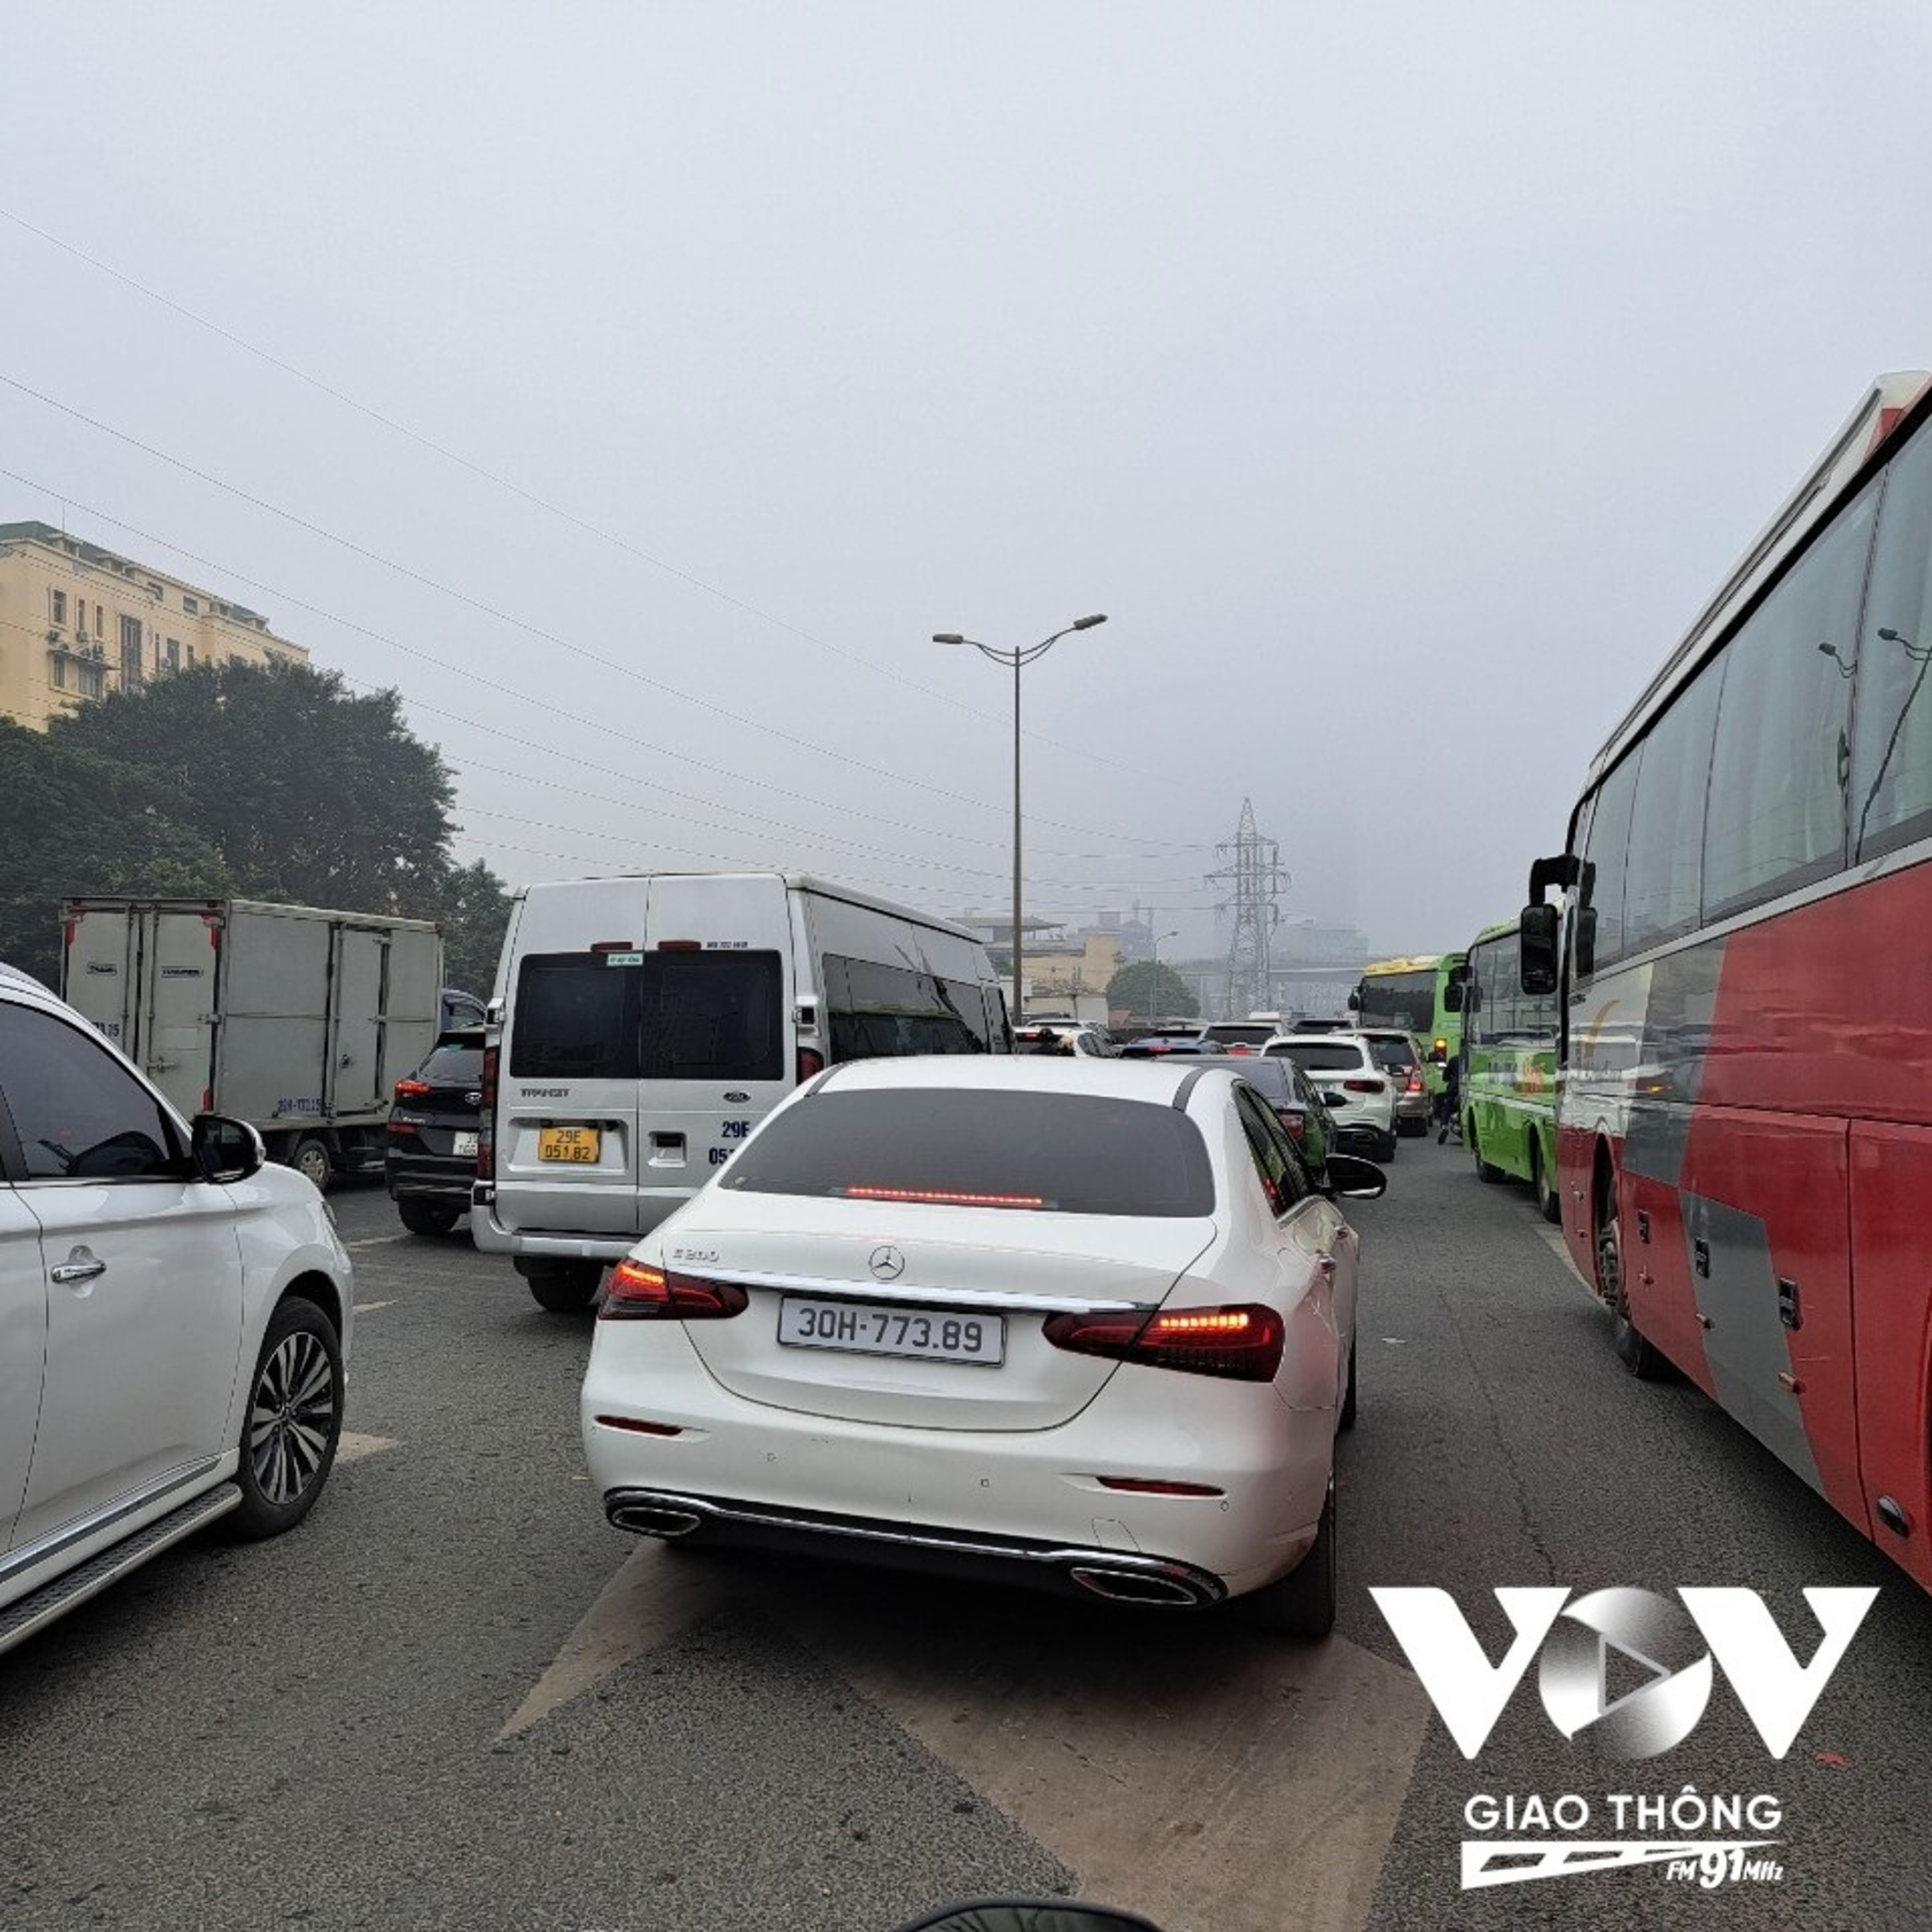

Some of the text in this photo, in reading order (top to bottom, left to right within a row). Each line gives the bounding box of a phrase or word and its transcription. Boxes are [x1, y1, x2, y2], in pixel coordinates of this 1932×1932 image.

[555, 1130, 581, 1144] 29E
[545, 1144, 591, 1160] 051.82
[797, 1307, 983, 1353] 30H-773.89
